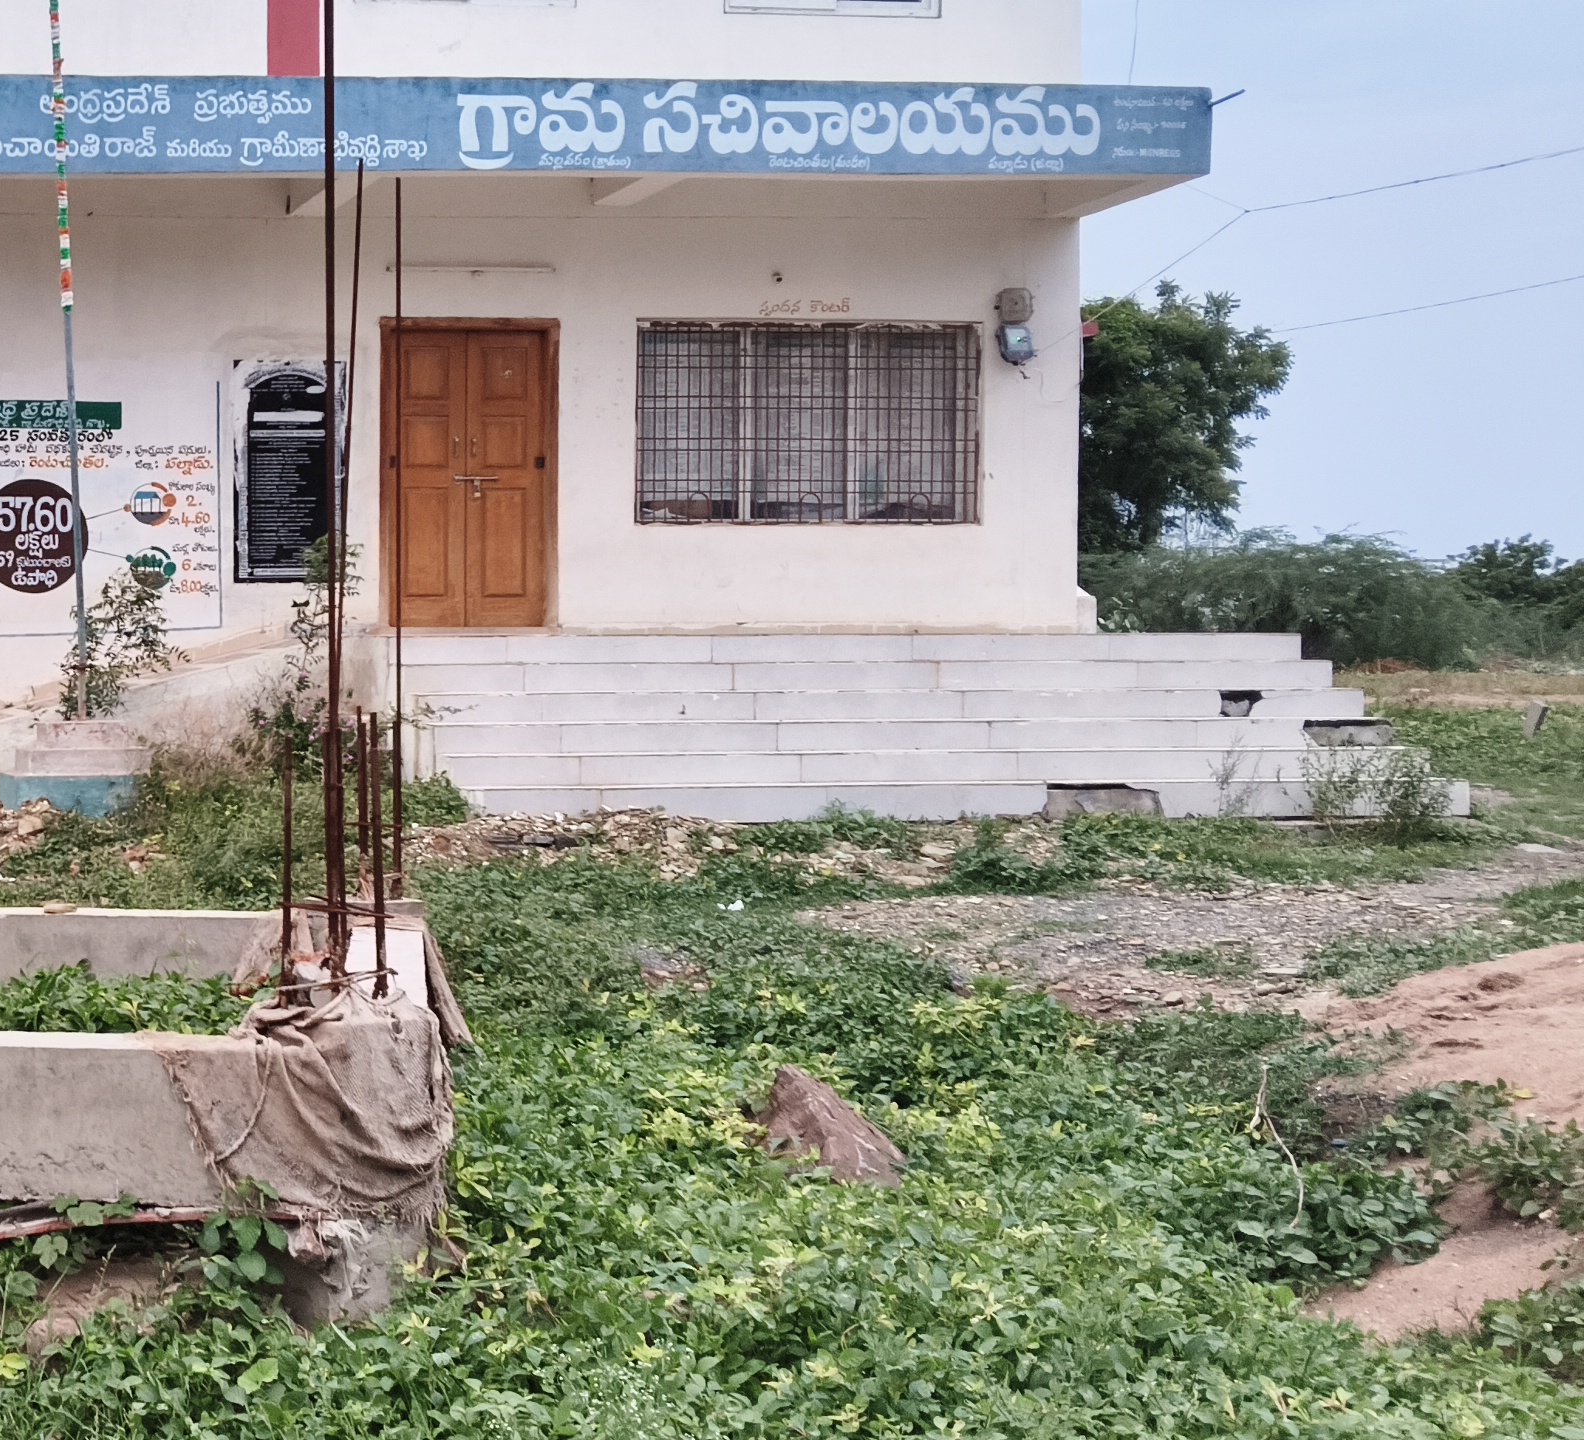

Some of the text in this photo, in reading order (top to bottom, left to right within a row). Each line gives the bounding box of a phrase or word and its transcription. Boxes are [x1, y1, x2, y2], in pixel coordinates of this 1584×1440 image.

[193, 89, 312, 124] ప్రభుత్వము
[456, 81, 1101, 170] గ్రామ సచివాలయము
[166, 138, 232, 159] మరియు
[14, 531, 60, 558] లక్షలు
[181, 558, 192, 571] 6
[11, 566, 58, 588] ఉపాధి
